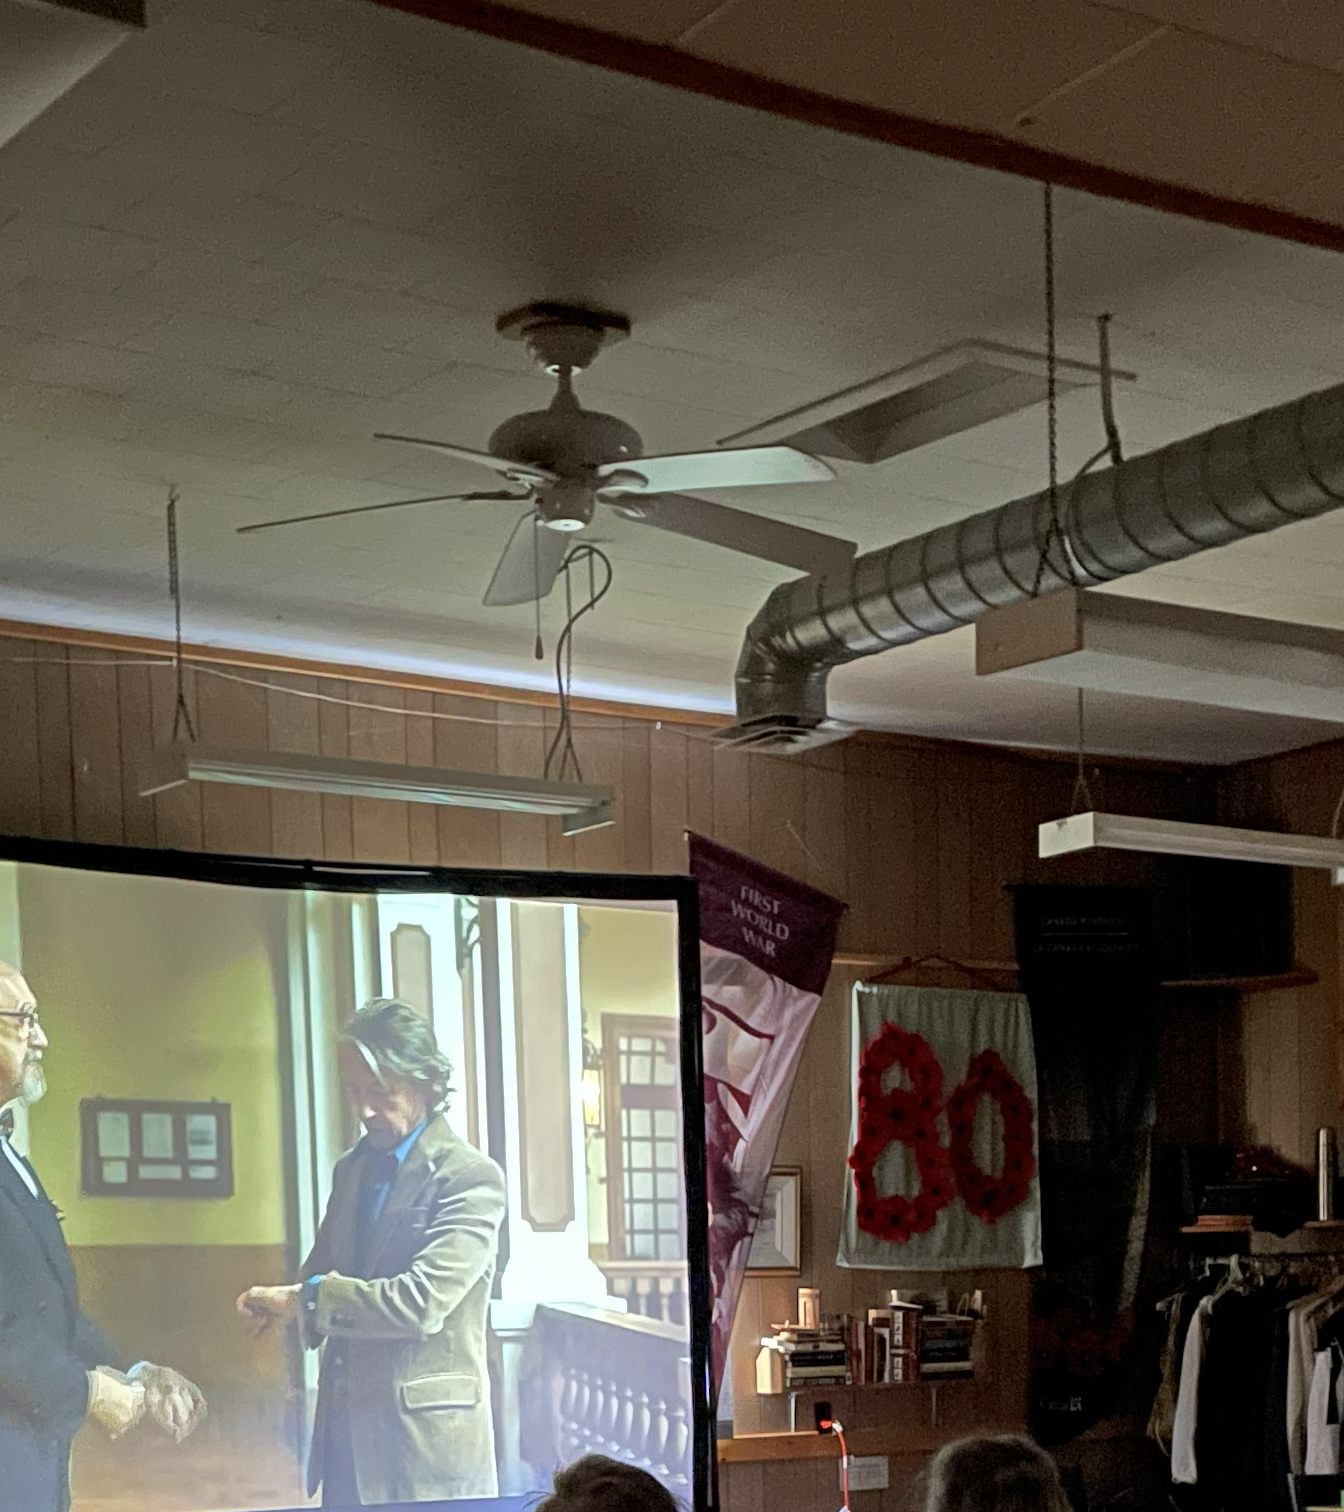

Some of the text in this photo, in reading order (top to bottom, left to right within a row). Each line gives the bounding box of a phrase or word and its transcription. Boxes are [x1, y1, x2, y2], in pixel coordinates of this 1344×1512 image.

[740, 886, 781, 915] FIRST
[731, 899, 790, 940] WORLD
[742, 926, 776, 958] WAR
[849, 1020, 1036, 1244] 80
